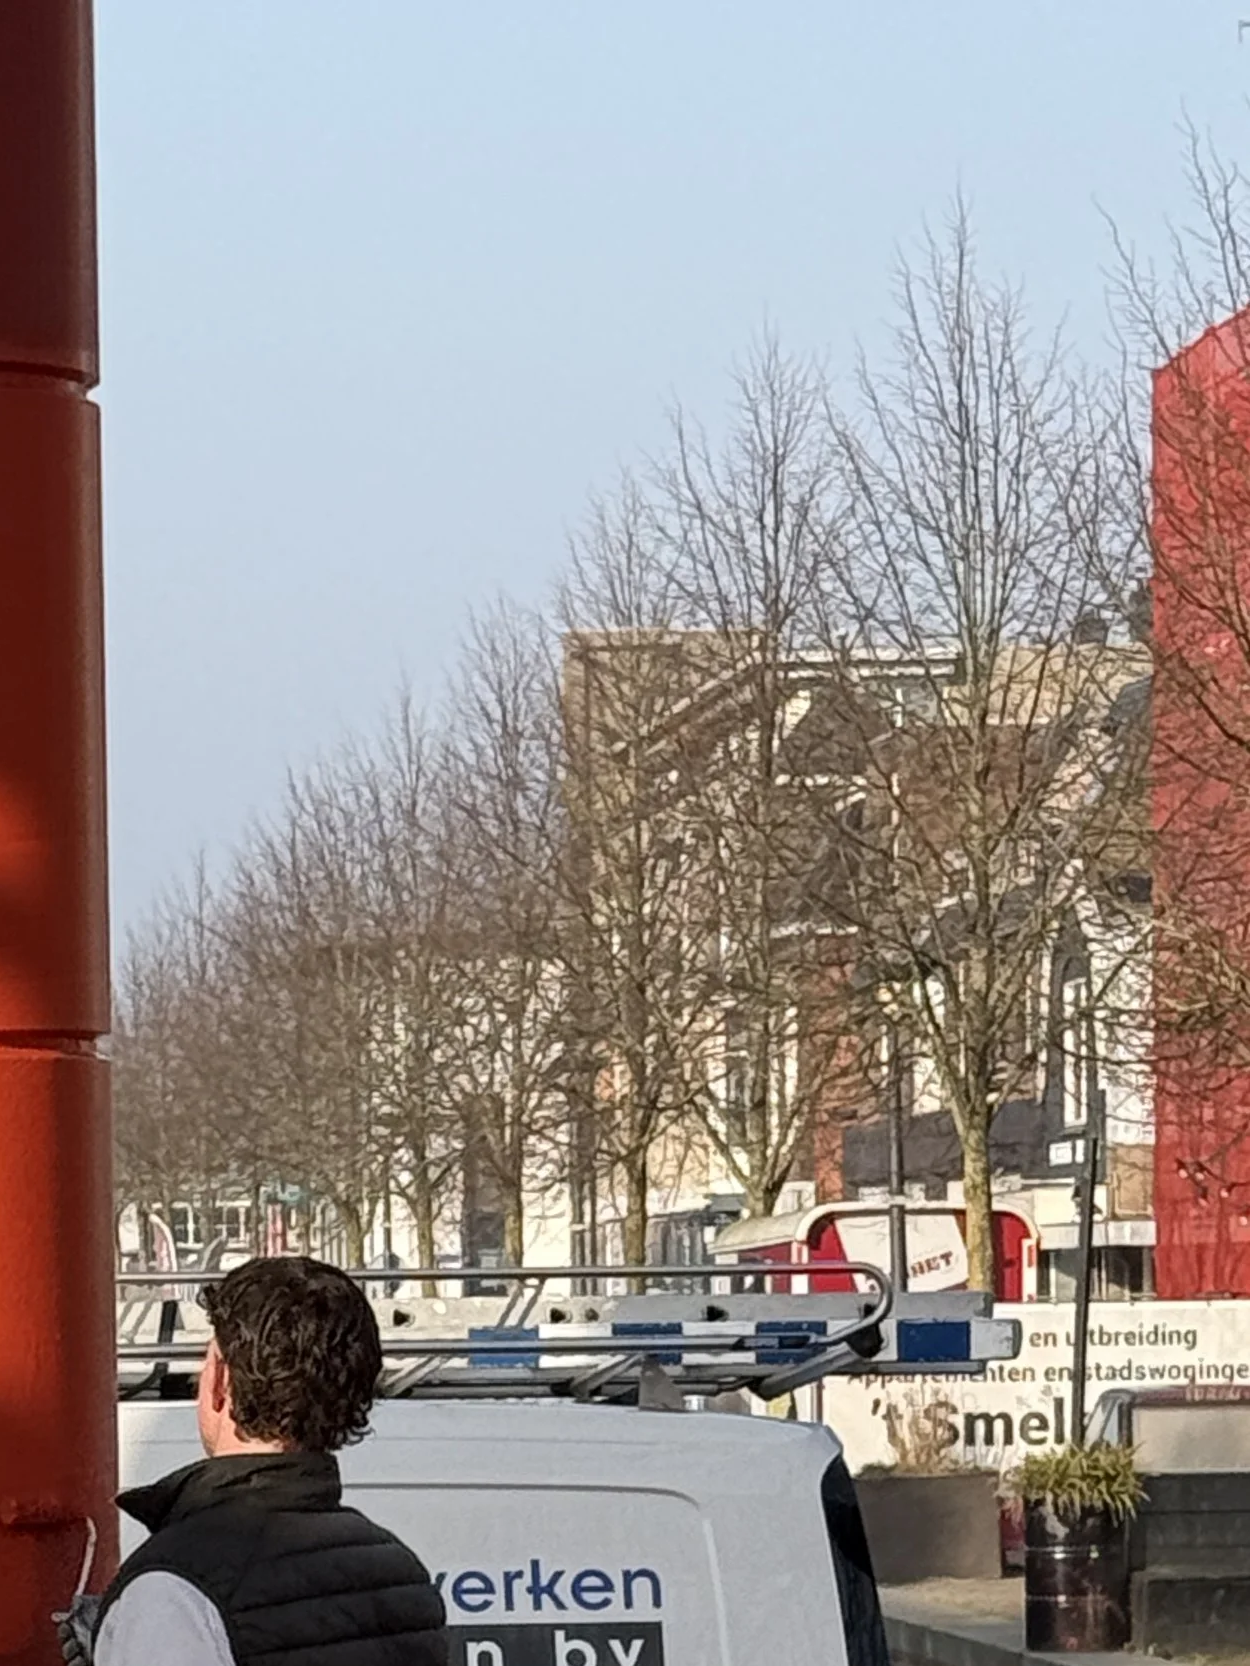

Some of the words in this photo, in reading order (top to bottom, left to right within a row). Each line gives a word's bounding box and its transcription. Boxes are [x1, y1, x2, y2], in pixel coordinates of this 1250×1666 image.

[1029, 1331, 1057, 1347] en
[1066, 1323, 1197, 1350] utbreiding
[1044, 1366, 1073, 1382] en
[923, 1397, 1086, 1447] Smel
